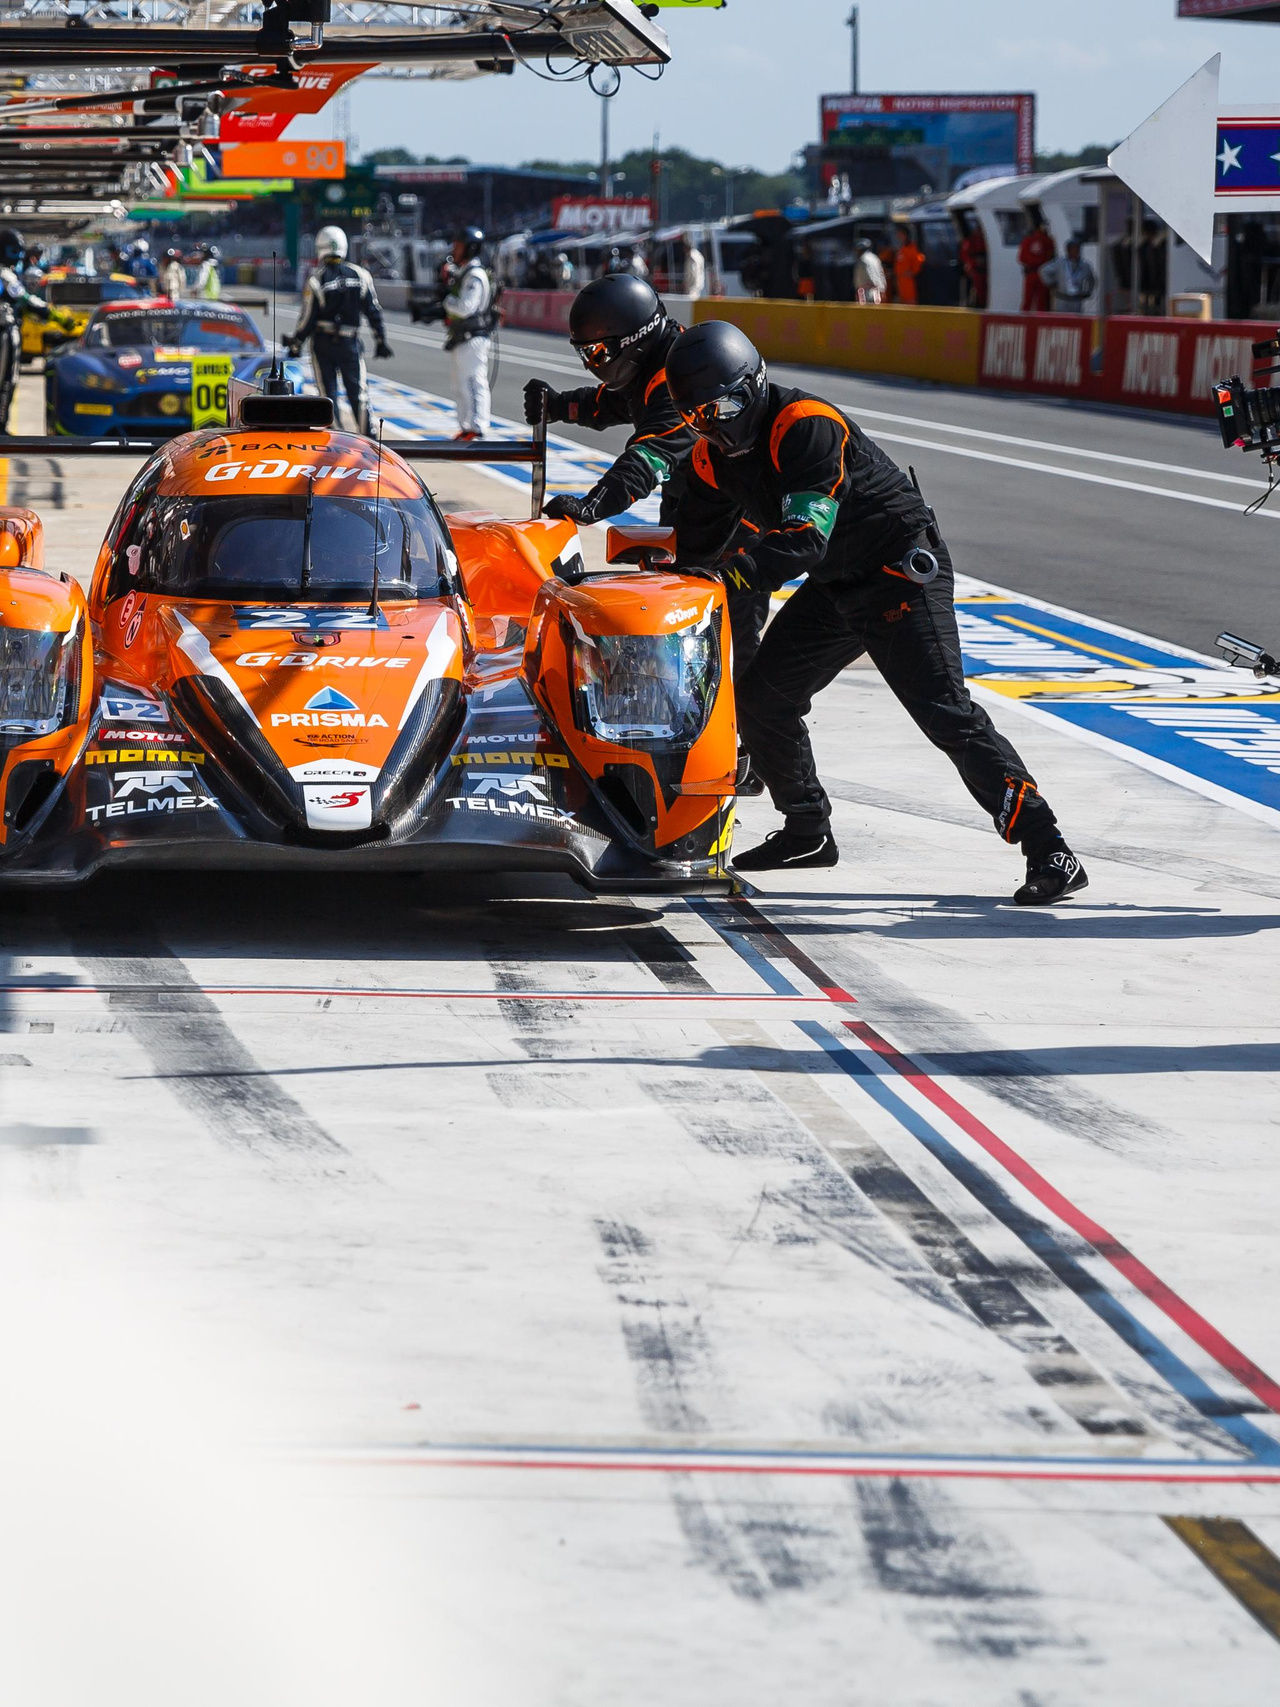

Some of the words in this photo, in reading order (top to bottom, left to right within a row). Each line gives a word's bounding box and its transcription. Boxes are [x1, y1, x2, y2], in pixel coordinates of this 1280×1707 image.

[305, 145, 338, 171] 90
[556, 203, 651, 228] MOTUL
[196, 384, 227, 411] 06
[250, 611, 378, 628] 22
[106, 700, 164, 719] P2
[270, 713, 390, 728] PRISMA
[103, 730, 186, 742] MOTUL
[466, 733, 547, 744] MOTUL
[85, 796, 220, 821] TELMEX
[445, 797, 579, 828] TELMEX
